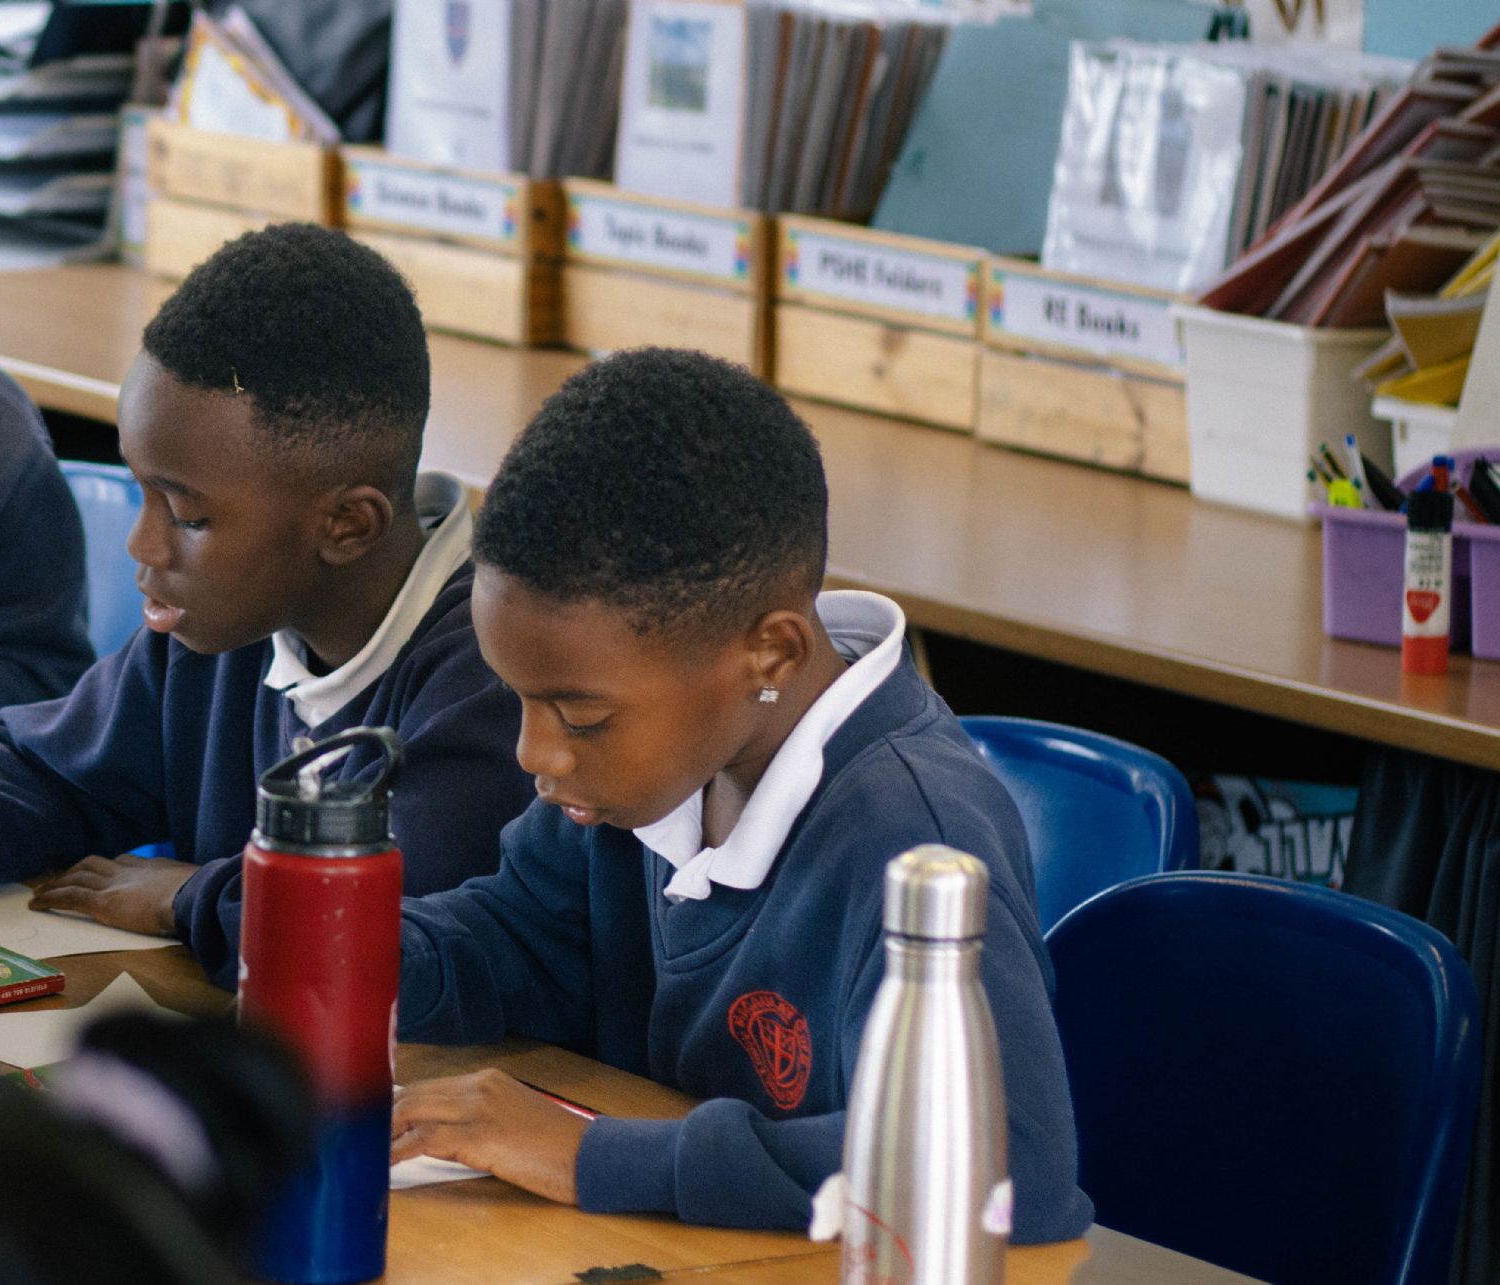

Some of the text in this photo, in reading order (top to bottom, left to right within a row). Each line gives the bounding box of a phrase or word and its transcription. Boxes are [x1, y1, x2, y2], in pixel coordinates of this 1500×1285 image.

[654, 224, 709, 257] Books
[819, 250, 943, 298] PSHE Folders
[1043, 297, 1140, 341] RE Books
[1, 991, 12, 999] AND
[12, 988, 24, 996] TOM
[24, 983, 48, 994] OLDFIELD
